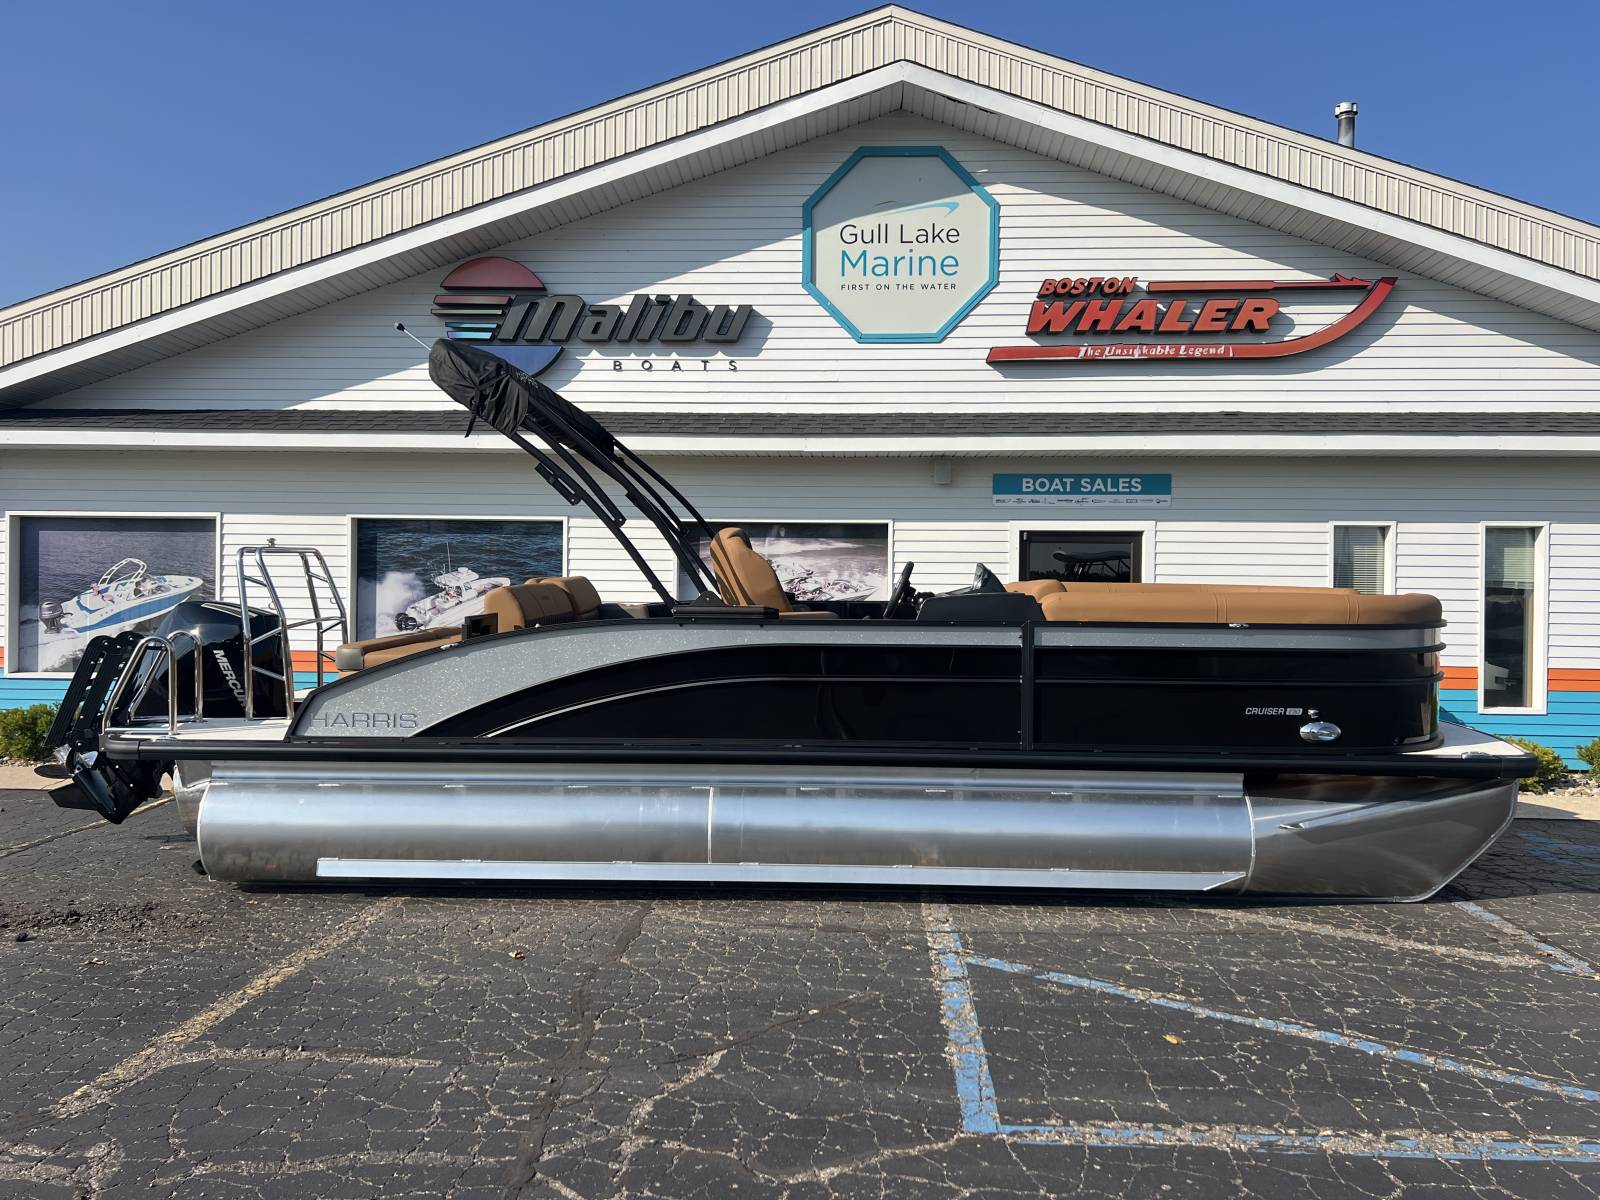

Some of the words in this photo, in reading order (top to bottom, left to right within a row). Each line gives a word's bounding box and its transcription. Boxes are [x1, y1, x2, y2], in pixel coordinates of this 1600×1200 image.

[840, 224, 888, 244] Gull
[900, 223, 960, 244] Lake
[841, 249, 959, 277] Marine
[1038, 277, 1138, 298] BOSTON
[497, 294, 753, 343] Malibu
[1026, 298, 1280, 335] WHALER
[1078, 344, 1101, 358] The
[1180, 345, 1225, 357] Legend
[613, 360, 738, 371] BOATS
[1022, 478, 1074, 492] BOAT
[1080, 478, 1142, 492] SALES
[212, 649, 247, 711] MERCU
[310, 711, 417, 729] HARRIS
[1245, 707, 1285, 715] CRUISER
